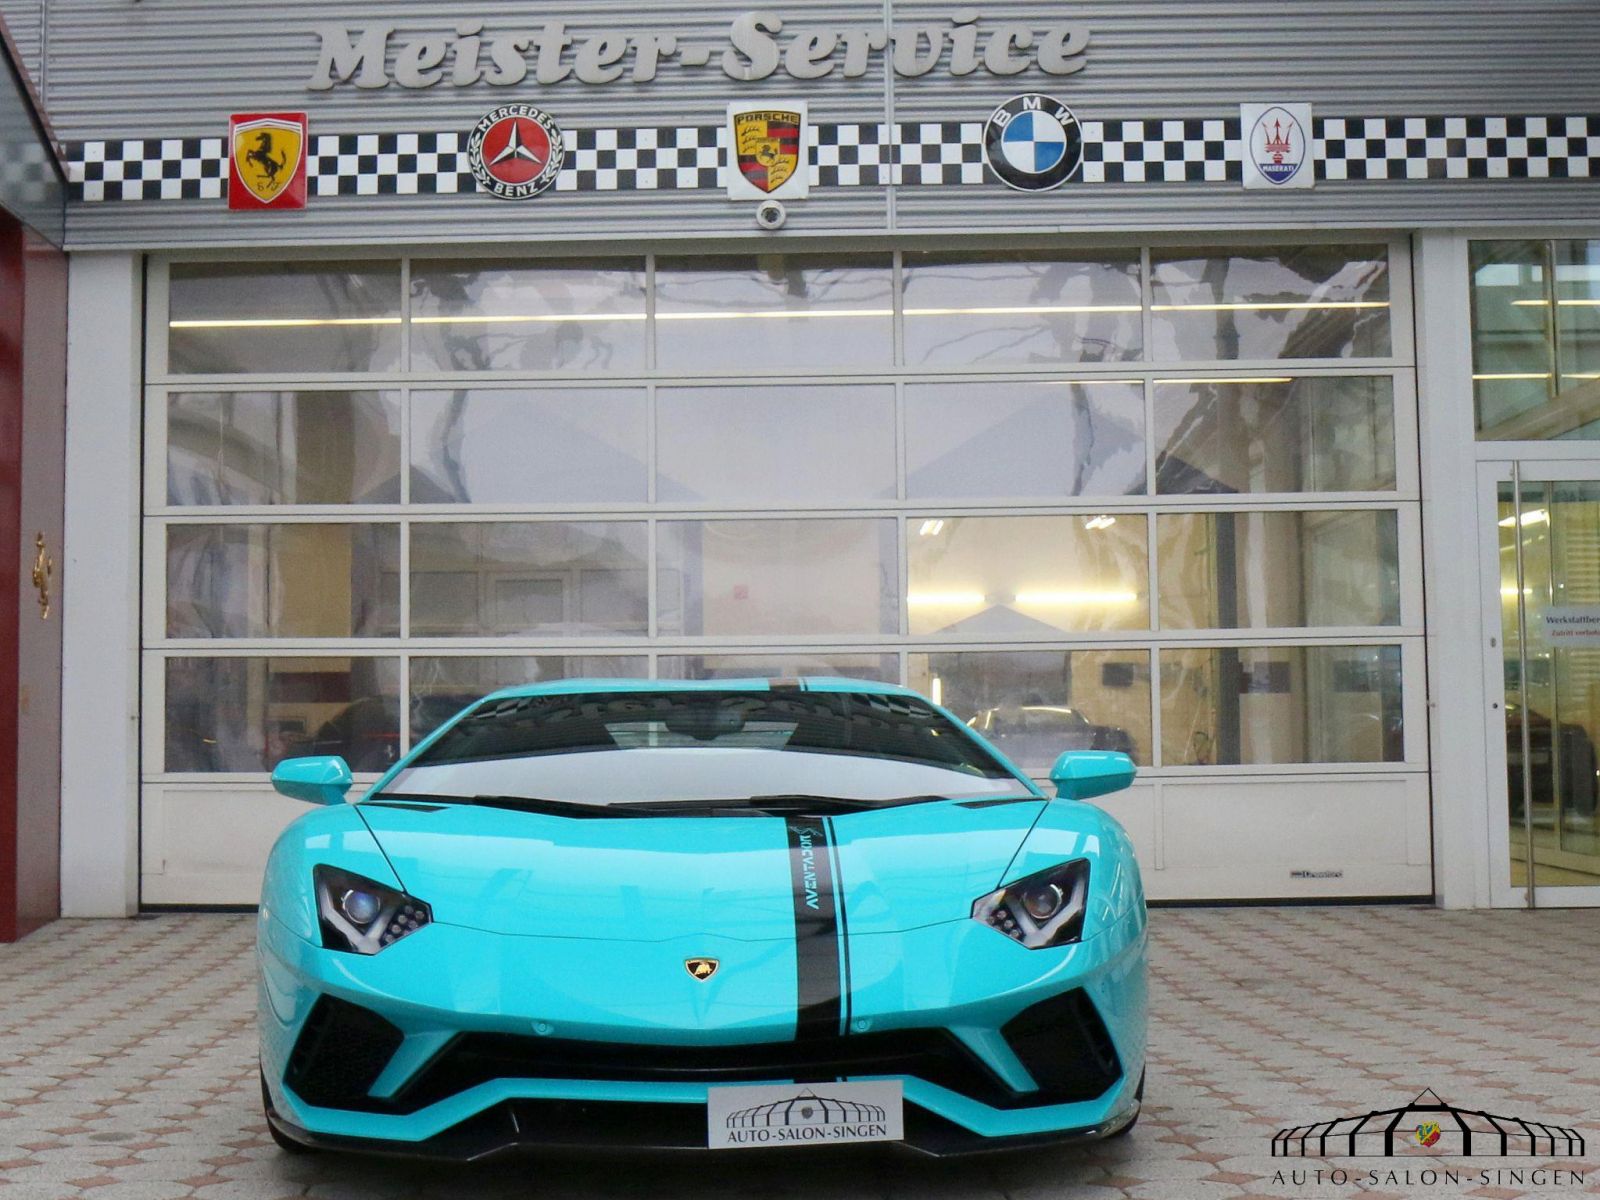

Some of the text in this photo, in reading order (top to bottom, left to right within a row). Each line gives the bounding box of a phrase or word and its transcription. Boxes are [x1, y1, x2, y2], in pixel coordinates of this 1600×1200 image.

[305, 8, 1091, 91] Meister-Service
[478, 105, 554, 132] MERCEDES
[735, 112, 799, 125] PORSCHE
[993, 96, 1075, 127] BMW
[493, 182, 538, 197] BENZ
[799, 834, 820, 910] AVENTADOR
[727, 1123, 887, 1144] AUTO-SALON-SINGEN
